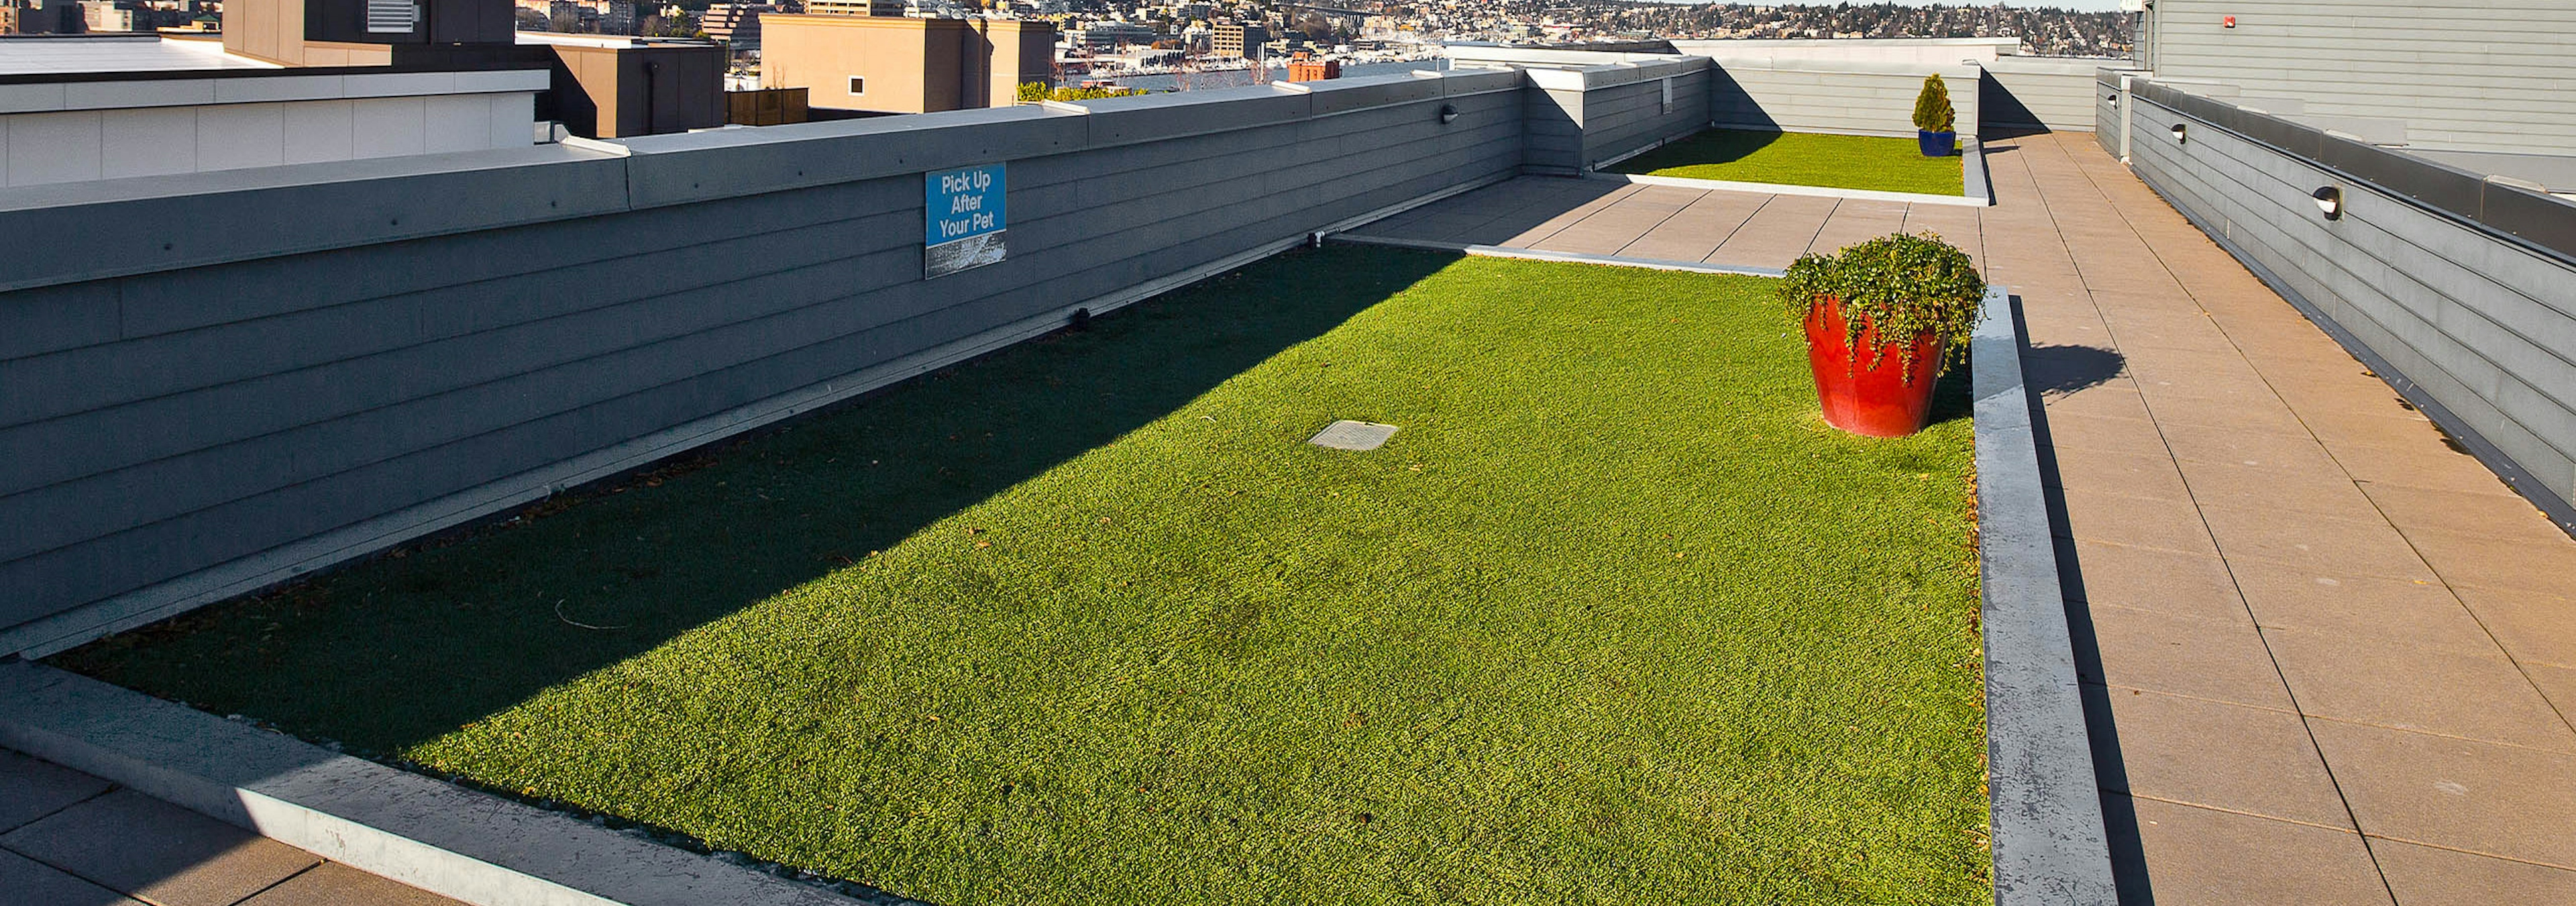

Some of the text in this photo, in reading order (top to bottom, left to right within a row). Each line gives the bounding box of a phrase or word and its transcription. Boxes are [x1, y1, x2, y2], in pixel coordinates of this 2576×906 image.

[943, 170, 991, 194] Pick Up
[951, 194, 983, 214] After
[940, 211, 994, 238] Your Pet
